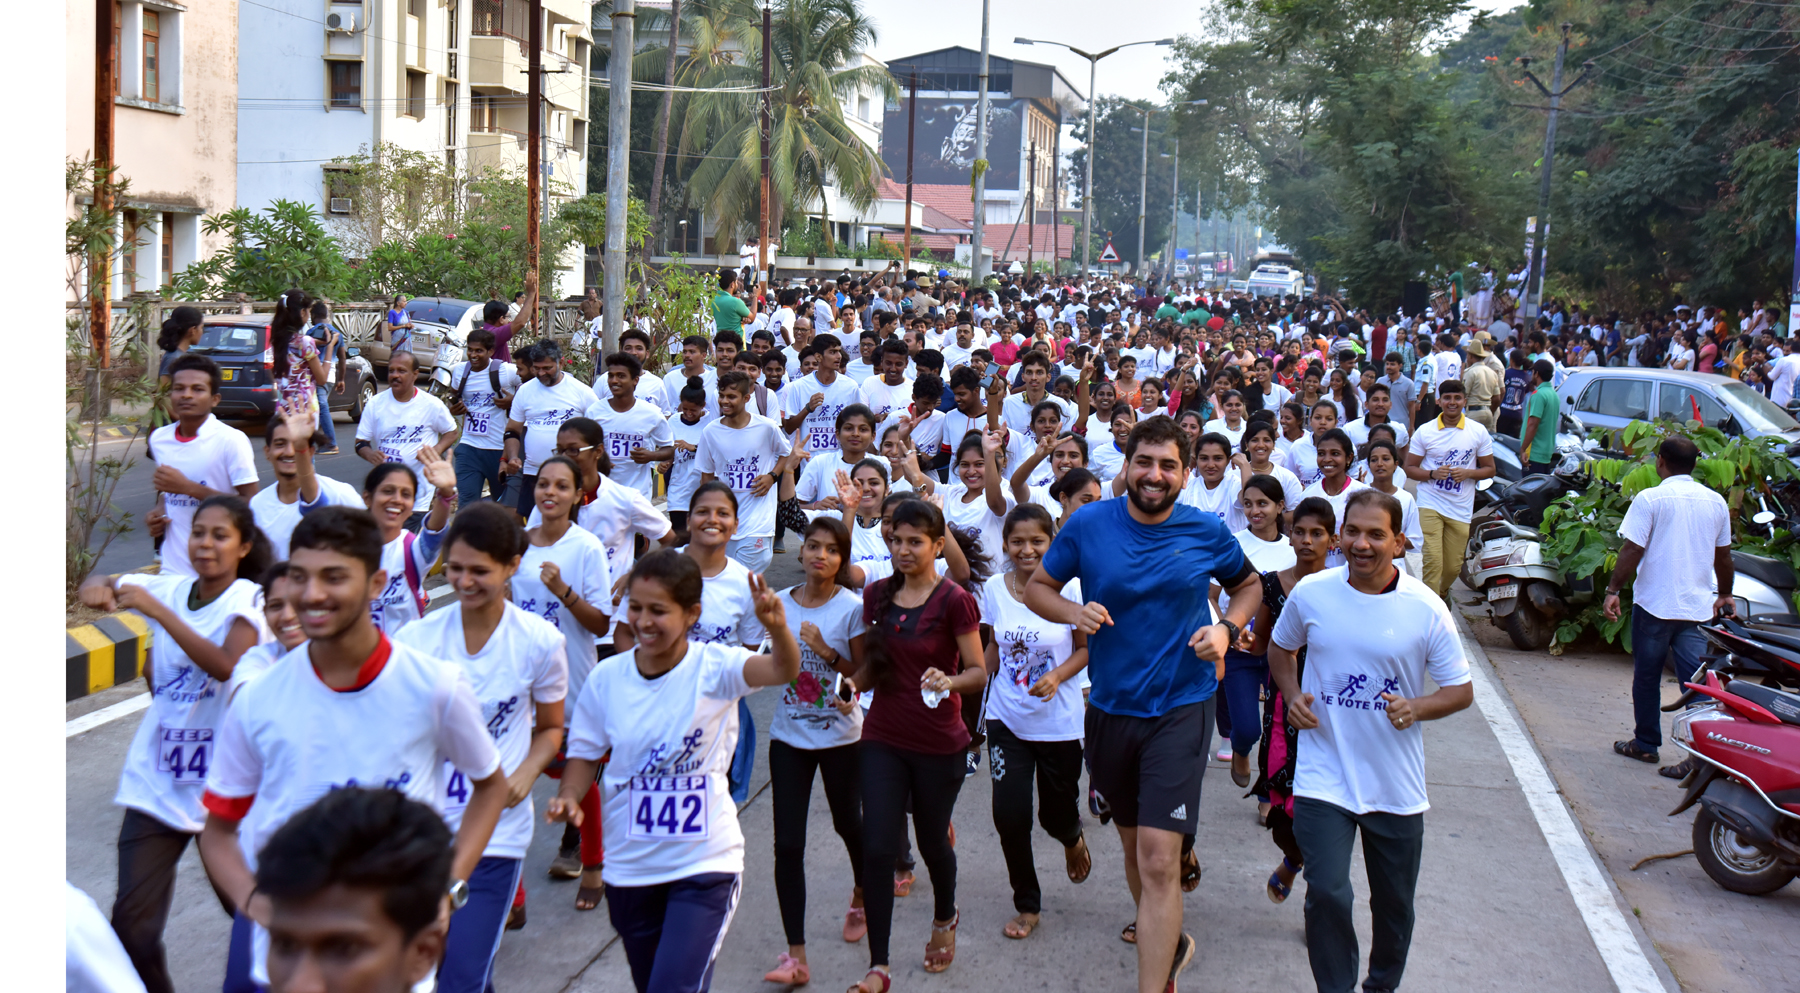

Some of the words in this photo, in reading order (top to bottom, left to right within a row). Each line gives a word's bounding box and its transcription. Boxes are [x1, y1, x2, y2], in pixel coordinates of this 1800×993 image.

[467, 418, 488, 434] 726
[610, 432, 644, 441] SVEEP
[812, 433, 838, 449] 534
[728, 472, 755, 489] 512
[1436, 476, 1461, 493] 464
[384, 594, 405, 606] RUN
[1003, 630, 1040, 643] RULES
[1337, 697, 1371, 710] VOTE
[1374, 701, 1387, 711] RU
[1706, 731, 1772, 755] MAESTRO
[631, 776, 706, 791] SVEEP
[635, 794, 703, 834] 442
